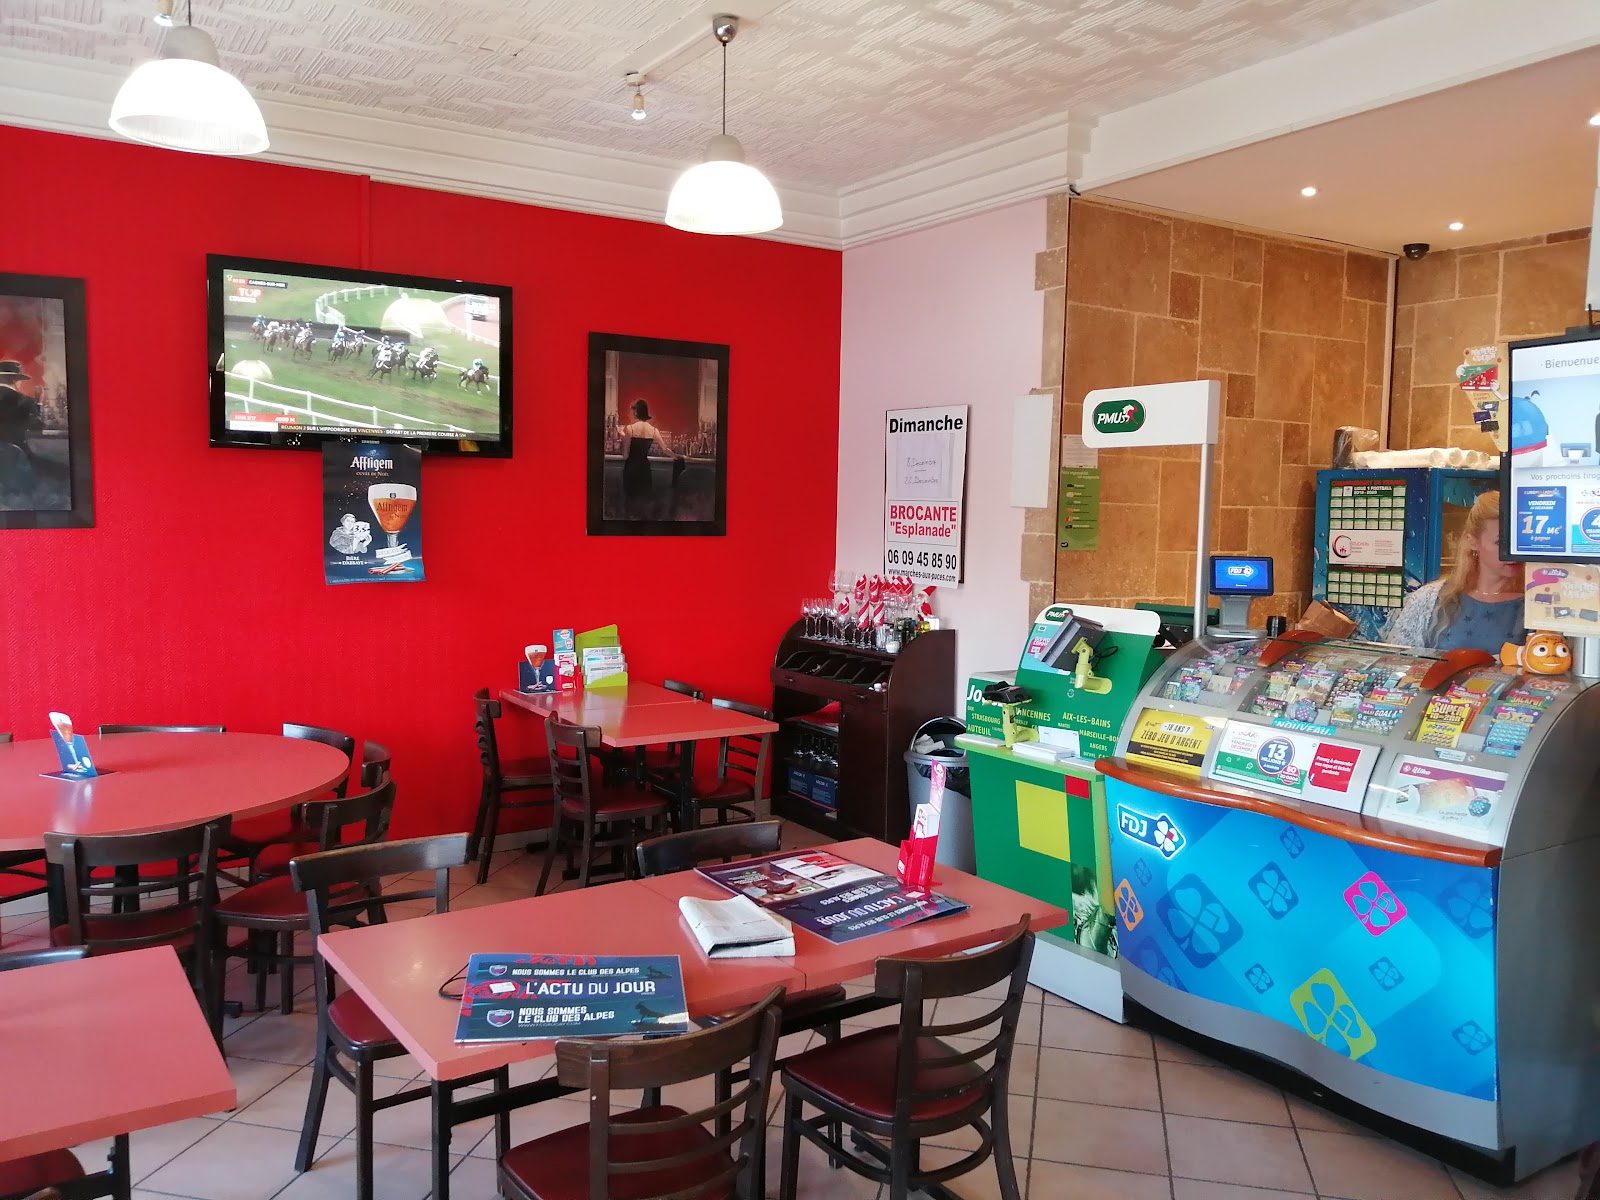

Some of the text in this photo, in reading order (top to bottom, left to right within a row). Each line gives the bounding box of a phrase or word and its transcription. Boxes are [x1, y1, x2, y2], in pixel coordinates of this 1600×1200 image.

[1545, 356, 1600, 369] Bienvenue
[889, 414, 964, 434] Dimanche
[1096, 412, 1122, 426] PMU
[350, 456, 394, 472] Affligem
[1546, 471, 1580, 481] prochains
[890, 504, 957, 522] BROCANTE
[890, 521, 957, 538] "Esplanade"
[1521, 515, 1550, 535] 17
[888, 549, 957, 570] 06 09 45 85 90
[888, 568, 956, 582] www.marches-aux-puces.com
[1433, 702, 1465, 715] SUPER
[972, 712, 1001, 724] STRASBOURG
[1062, 712, 1111, 728] AIX-LES-BAINS
[968, 724, 992, 736] AUTEUIL
[1164, 724, 1174, 732] -18
[1174, 725, 1186, 733] ANS
[1141, 728, 1202, 750] ZÉRO JEU D'ARGENT
[1267, 744, 1288, 760] 13
[1121, 810, 1148, 838] FDJ
[864, 895, 906, 912] L'ACTU
[816, 912, 852, 926] JOUR
[848, 906, 869, 918] DU
[534, 968, 564, 976] SOMMES
[526, 981, 656, 996] L'ACTU DU JOUR
[518, 1010, 615, 1024] LE CLUB DES ALPES
[519, 1006, 587, 1016] NOUS SOMMES
